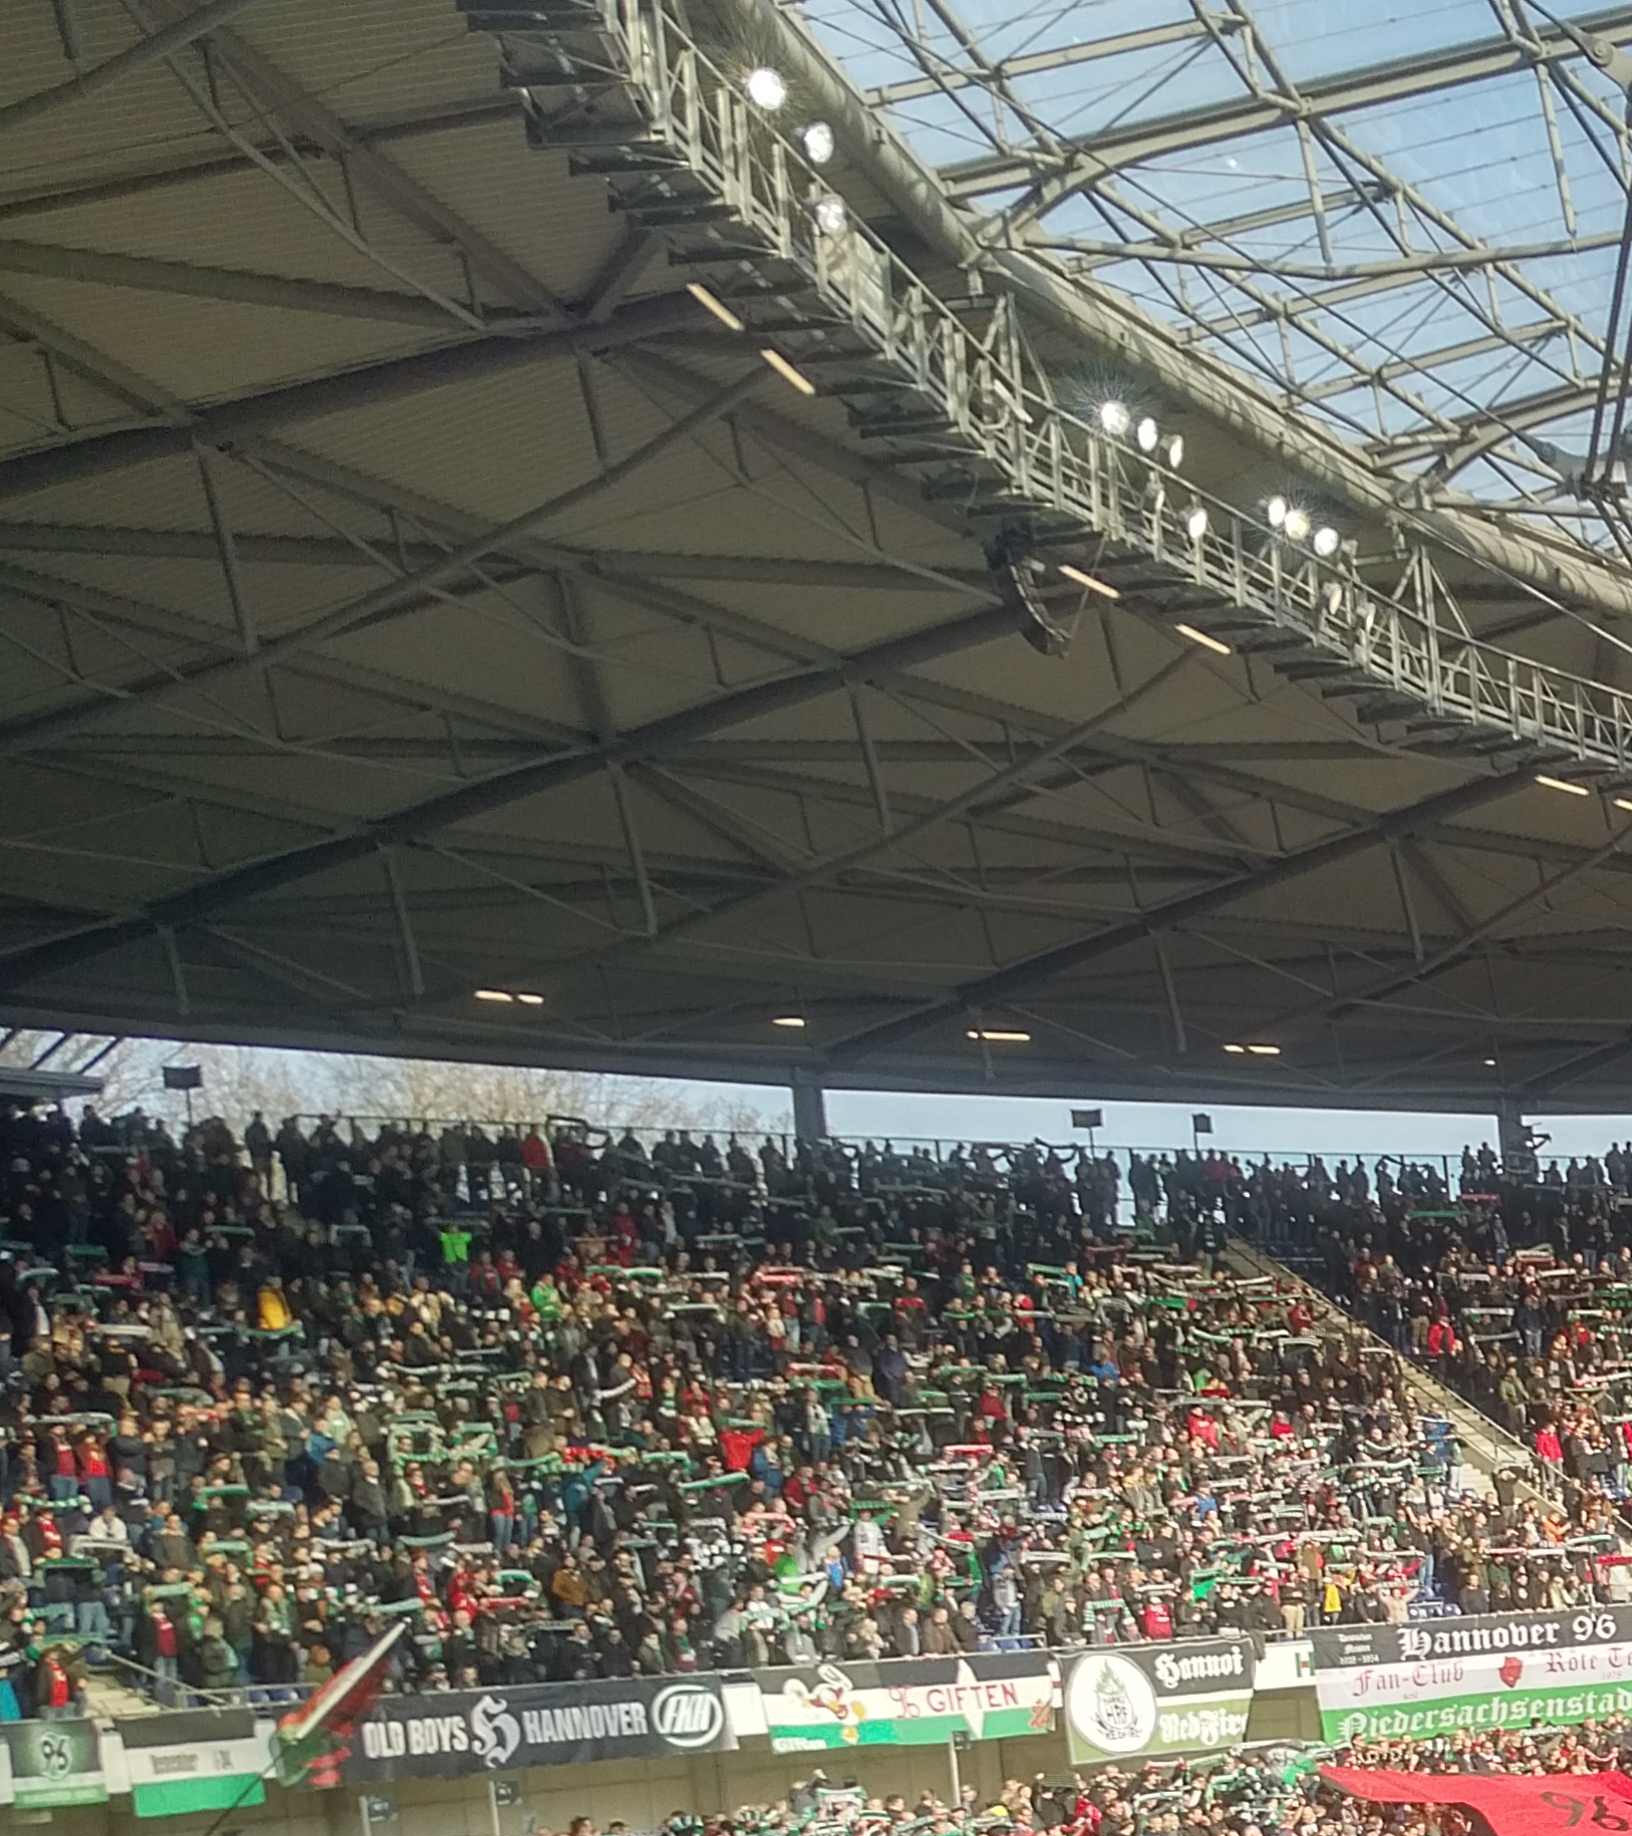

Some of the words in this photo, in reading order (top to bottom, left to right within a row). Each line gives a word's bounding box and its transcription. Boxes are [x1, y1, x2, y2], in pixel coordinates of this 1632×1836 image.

[1398, 1617, 1561, 1661] Hannover
[1572, 1614, 1616, 1641] 96
[926, 1682, 1018, 1713] GIFTEN
[362, 1720, 406, 1759] OLD
[407, 1715, 469, 1756] BOYS
[522, 1702, 648, 1744] HANNOVER
[1540, 1790, 1631, 1832] 96
